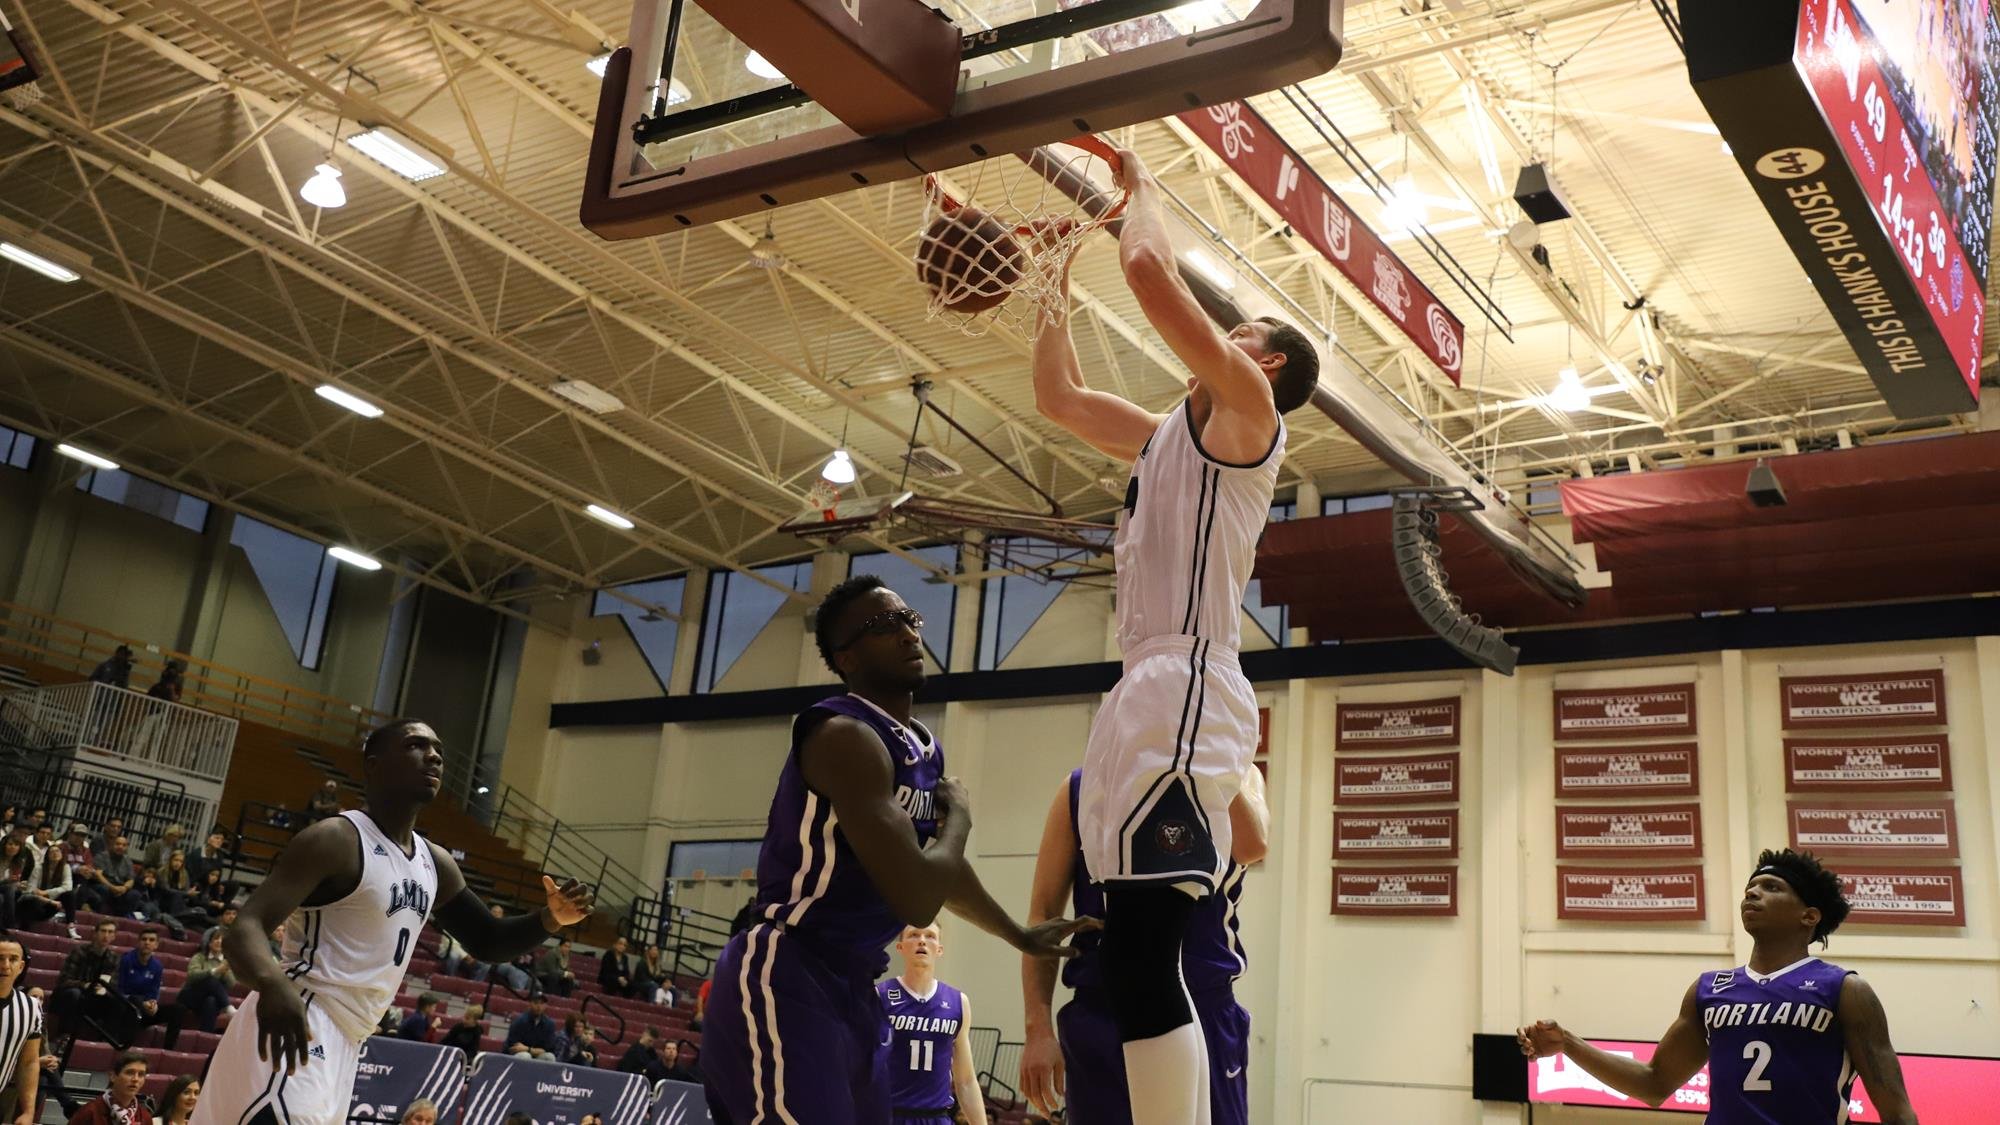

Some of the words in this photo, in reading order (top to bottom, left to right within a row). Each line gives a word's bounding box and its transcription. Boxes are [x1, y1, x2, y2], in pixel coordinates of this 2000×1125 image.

[1864, 81, 1886, 142] 49
[1771, 150, 1807, 176] 44
[1786, 180, 1859, 252] HOUSE
[1881, 173, 1924, 278] 14:13
[1928, 211, 1946, 269] 36
[1827, 251, 1897, 320] HANK'S
[1866, 318, 1907, 337] IS
[1876, 335, 1927, 374] THIS
[1839, 691, 1881, 706] WCC
[1604, 704, 1640, 717] WCC
[1801, 706, 1881, 715] CHAMPIONS
[1845, 754, 1884, 765] NCAA
[1840, 770, 1889, 778] ROUND
[1799, 811, 1859, 819] WOMEN'S
[1862, 811, 1941, 820] VOLLEYBALL
[1848, 819, 1890, 834] WCC
[1809, 835, 1892, 843] CHAMPIONS
[1855, 885, 1894, 895] NCAA
[1867, 877, 1947, 886] VOLLEYBALL
[386, 879, 429, 920] LMU
[393, 927, 410, 967] 0
[1705, 1002, 1834, 1033] PORTLAND
[910, 1039, 934, 1071] 11
[1743, 1040, 1772, 1091] 2
[536, 1082, 593, 1098] UNIVERSITY
